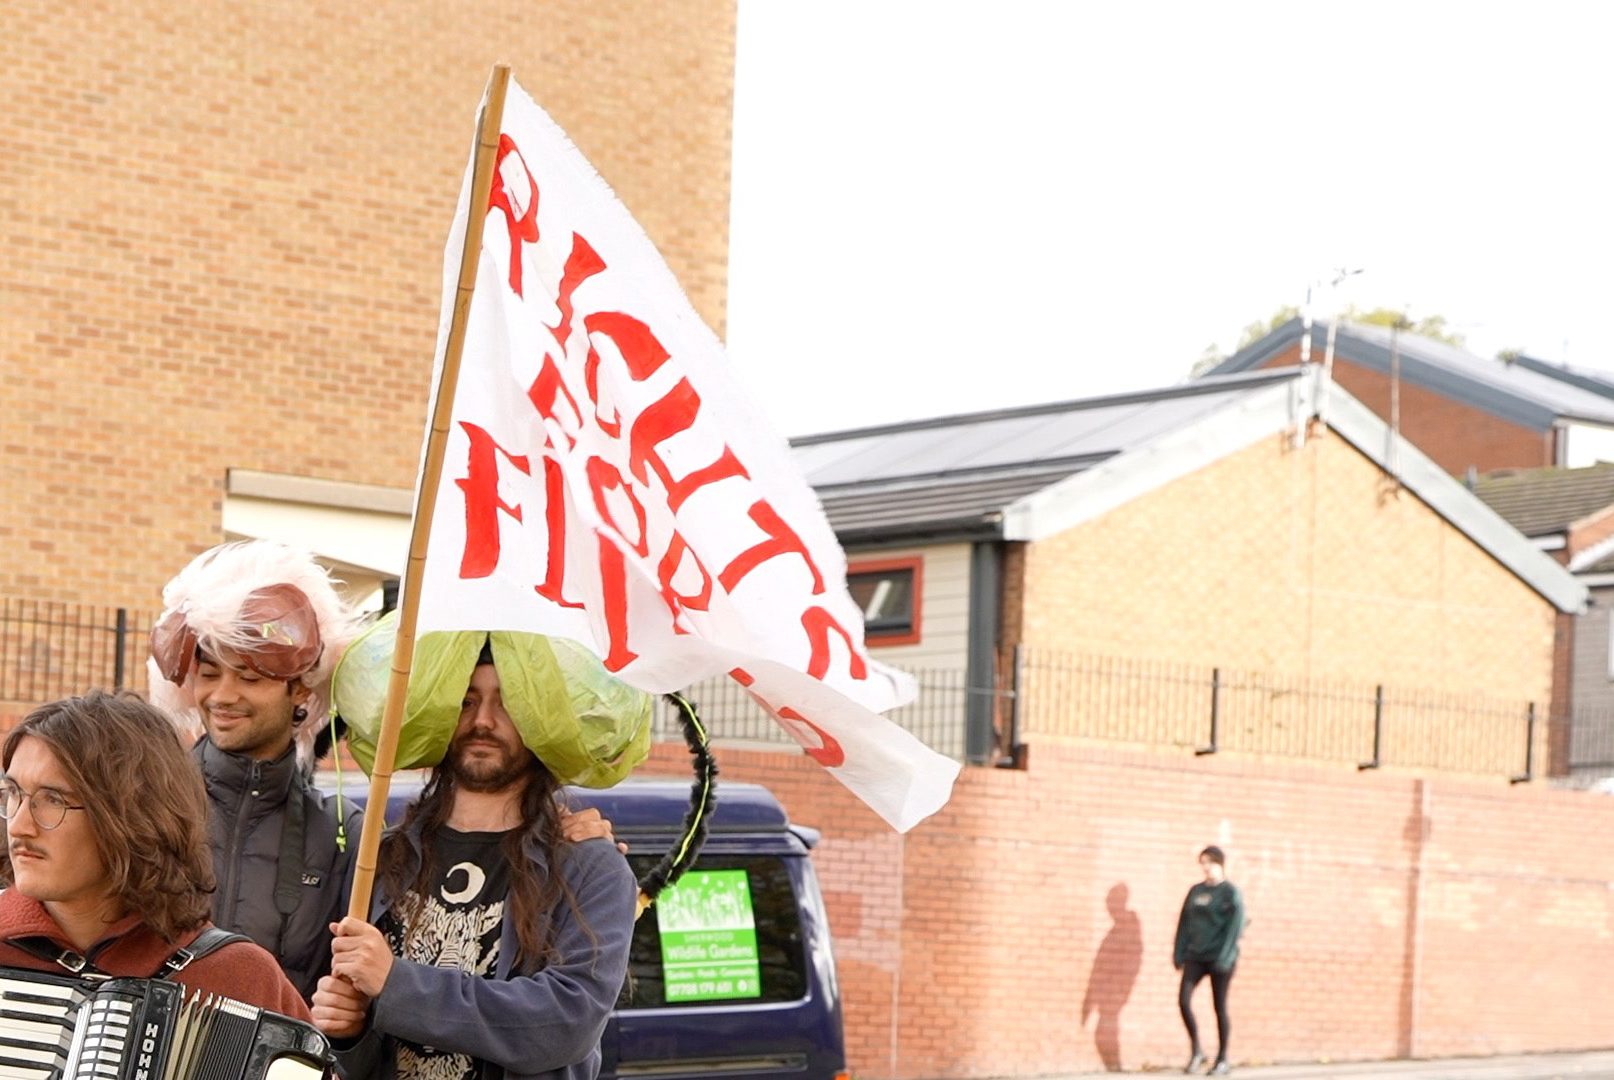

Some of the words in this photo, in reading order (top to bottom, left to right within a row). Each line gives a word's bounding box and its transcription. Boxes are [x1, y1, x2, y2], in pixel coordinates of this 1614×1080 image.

[487, 133, 868, 682] RIGHTS
[667, 944, 707, 960] Wildlife
[709, 943, 753, 959] Gardens
